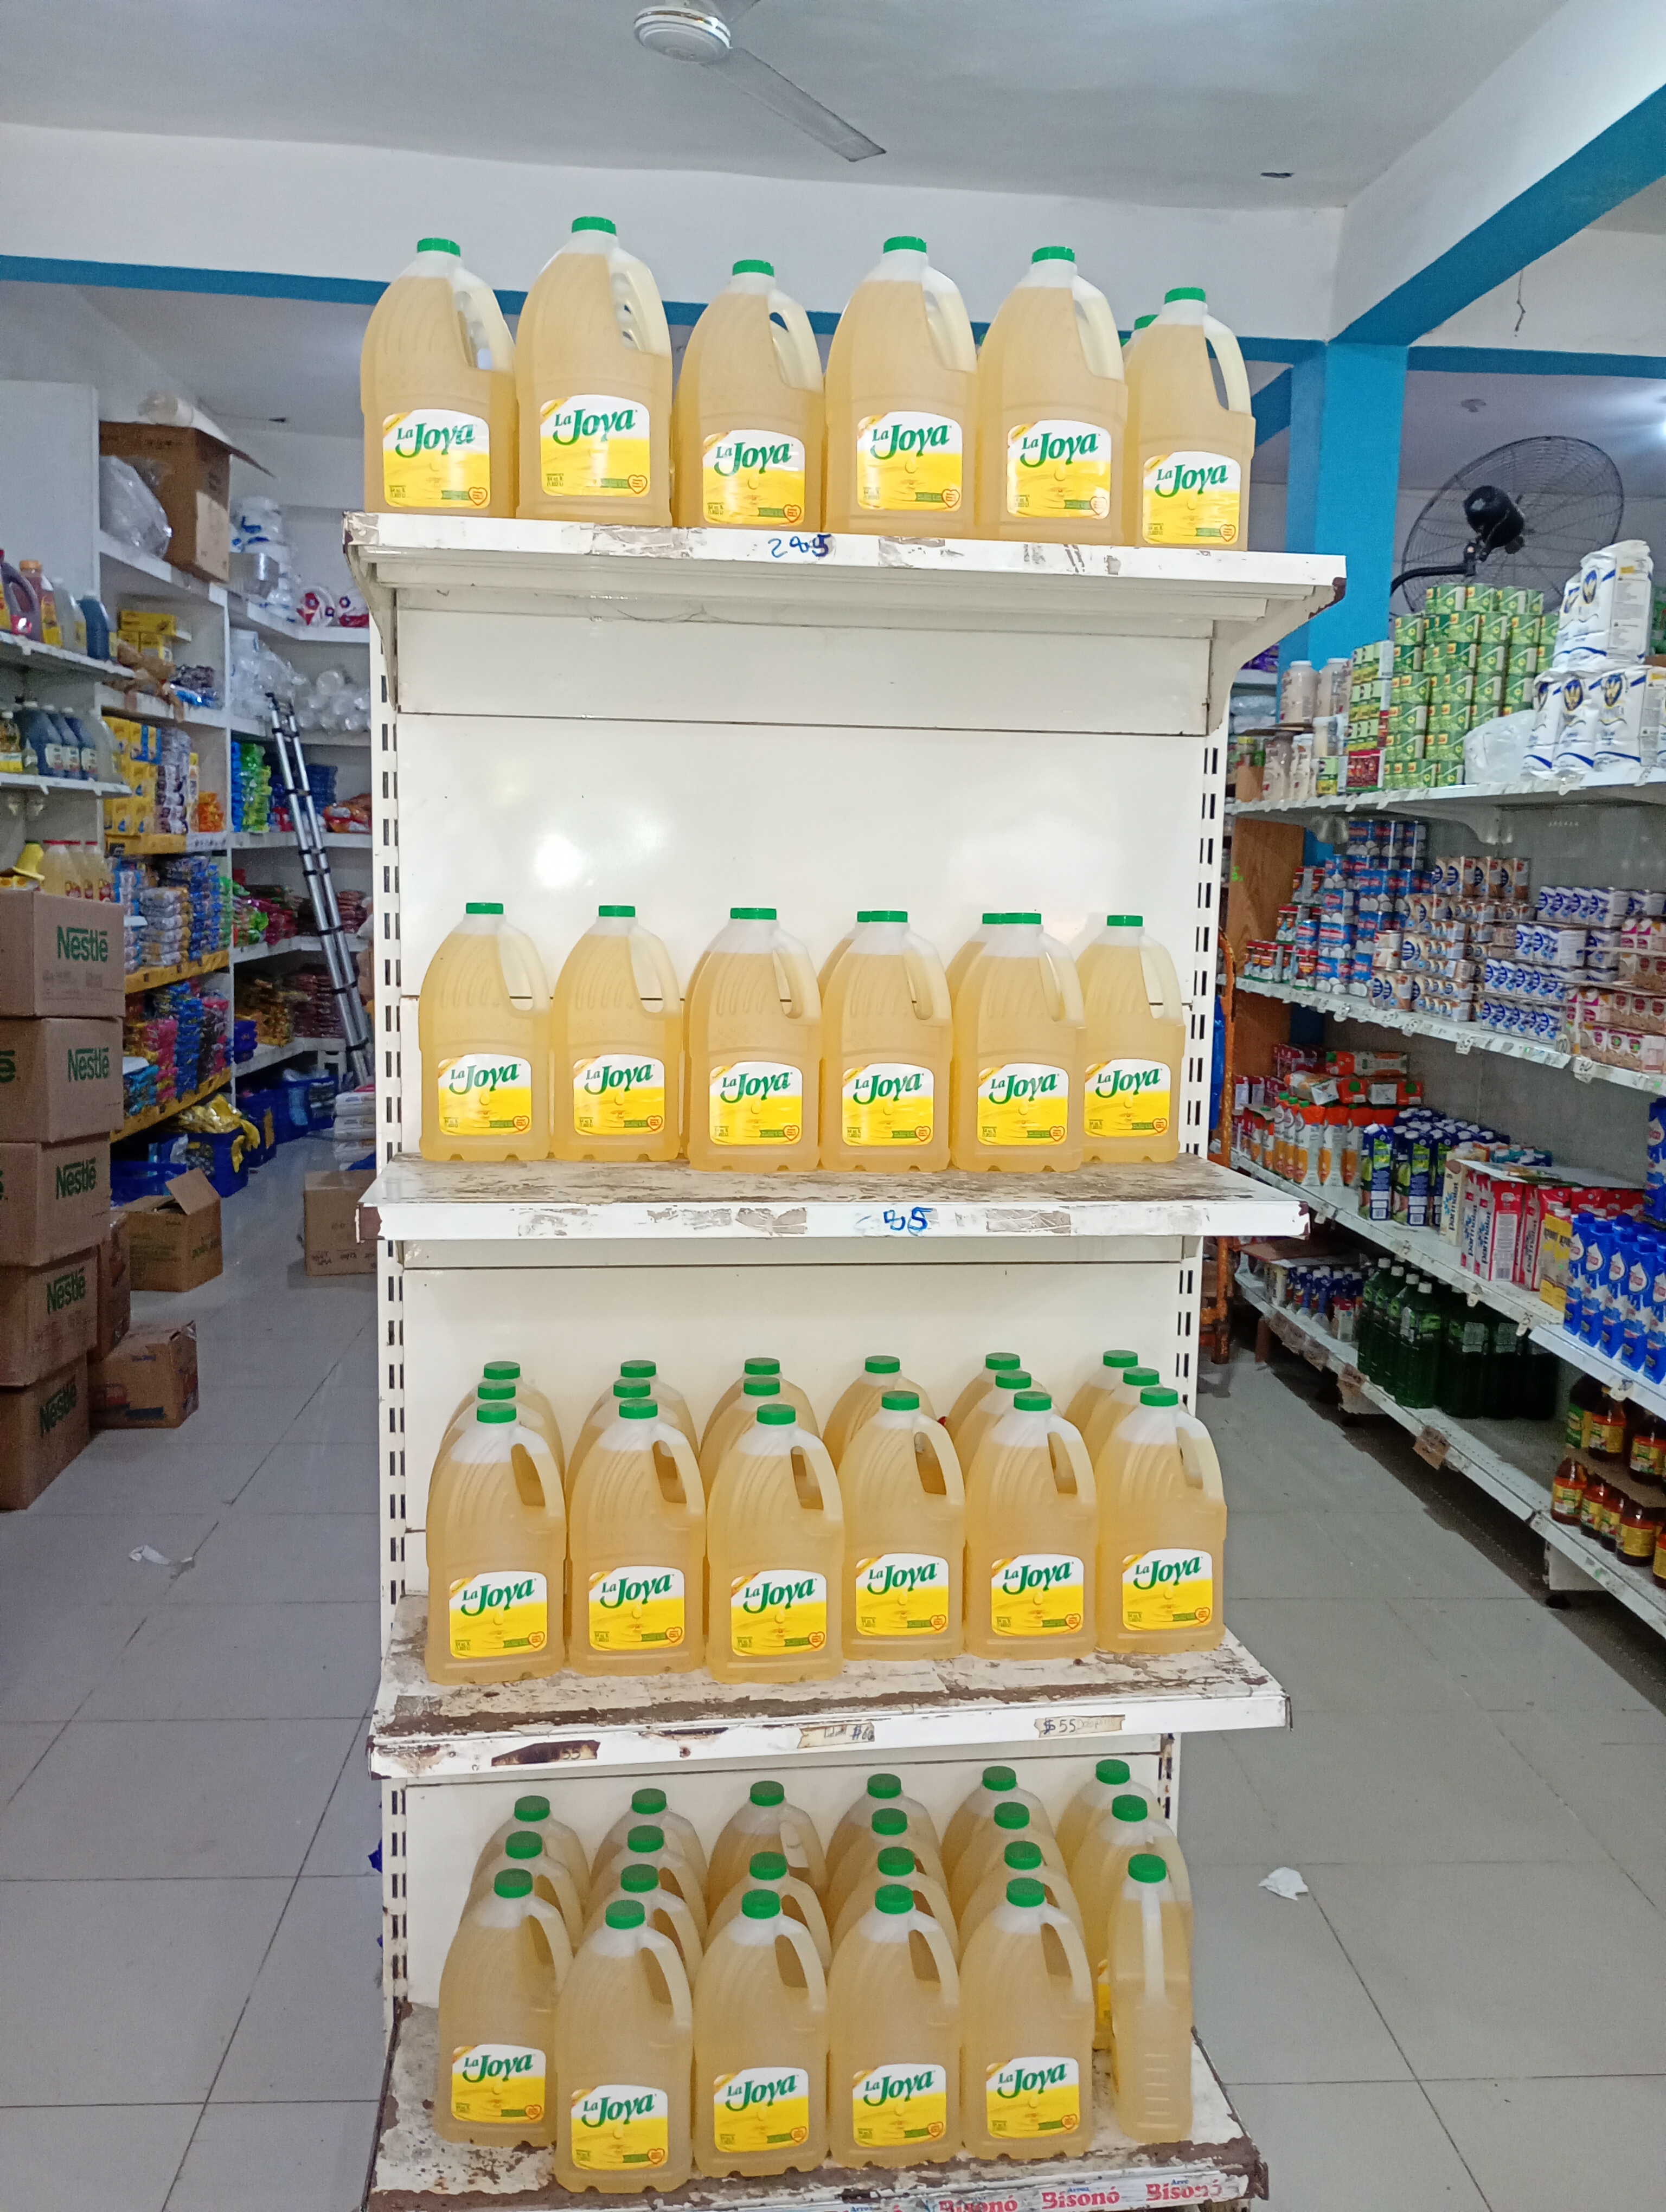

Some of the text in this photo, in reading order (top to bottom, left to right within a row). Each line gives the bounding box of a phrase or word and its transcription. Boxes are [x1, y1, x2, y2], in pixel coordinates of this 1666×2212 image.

[396, 428, 413, 440] La
[553, 409, 636, 445] Joya
[554, 414, 571, 427] La
[395, 423, 476, 458] Joya
[870, 424, 950, 460] La Joya
[1020, 432, 1098, 467] Joya
[1022, 436, 1039, 449] La
[714, 442, 792, 476] La Joya
[1155, 464, 1228, 498] La Joya
[57, 925, 108, 962] Nestlé
[68, 1047, 109, 1082] Nestlé
[449, 1064, 520, 1095] La Joya
[584, 1064, 653, 1095] La Joya
[1097, 1074, 1111, 1084] La
[720, 1072, 791, 1103] Joya
[722, 1077, 737, 1088] La
[853, 1073, 922, 1105] La Joya
[989, 1073, 1058, 1104] La Joya
[1095, 1069, 1161, 1098] Joya
[56, 1156, 96, 1200] Nestlé
[867, 1562, 937, 1594] La Joya
[1002, 1562, 1072, 1594] La Joya
[1133, 1557, 1201, 1590] La Joya
[461, 1579, 535, 1616] La Joya
[600, 1574, 672, 1608] La Joya
[743, 1578, 815, 1613] La Joya
[463, 2054, 533, 2082] La Joya
[997, 2063, 1067, 2099] La Joya
[725, 2075, 797, 2112] La Joya
[863, 2070, 935, 2107] La Joya
[581, 2094, 655, 2128] La Joya
[1042, 2186, 1120, 2209] Bisonó
